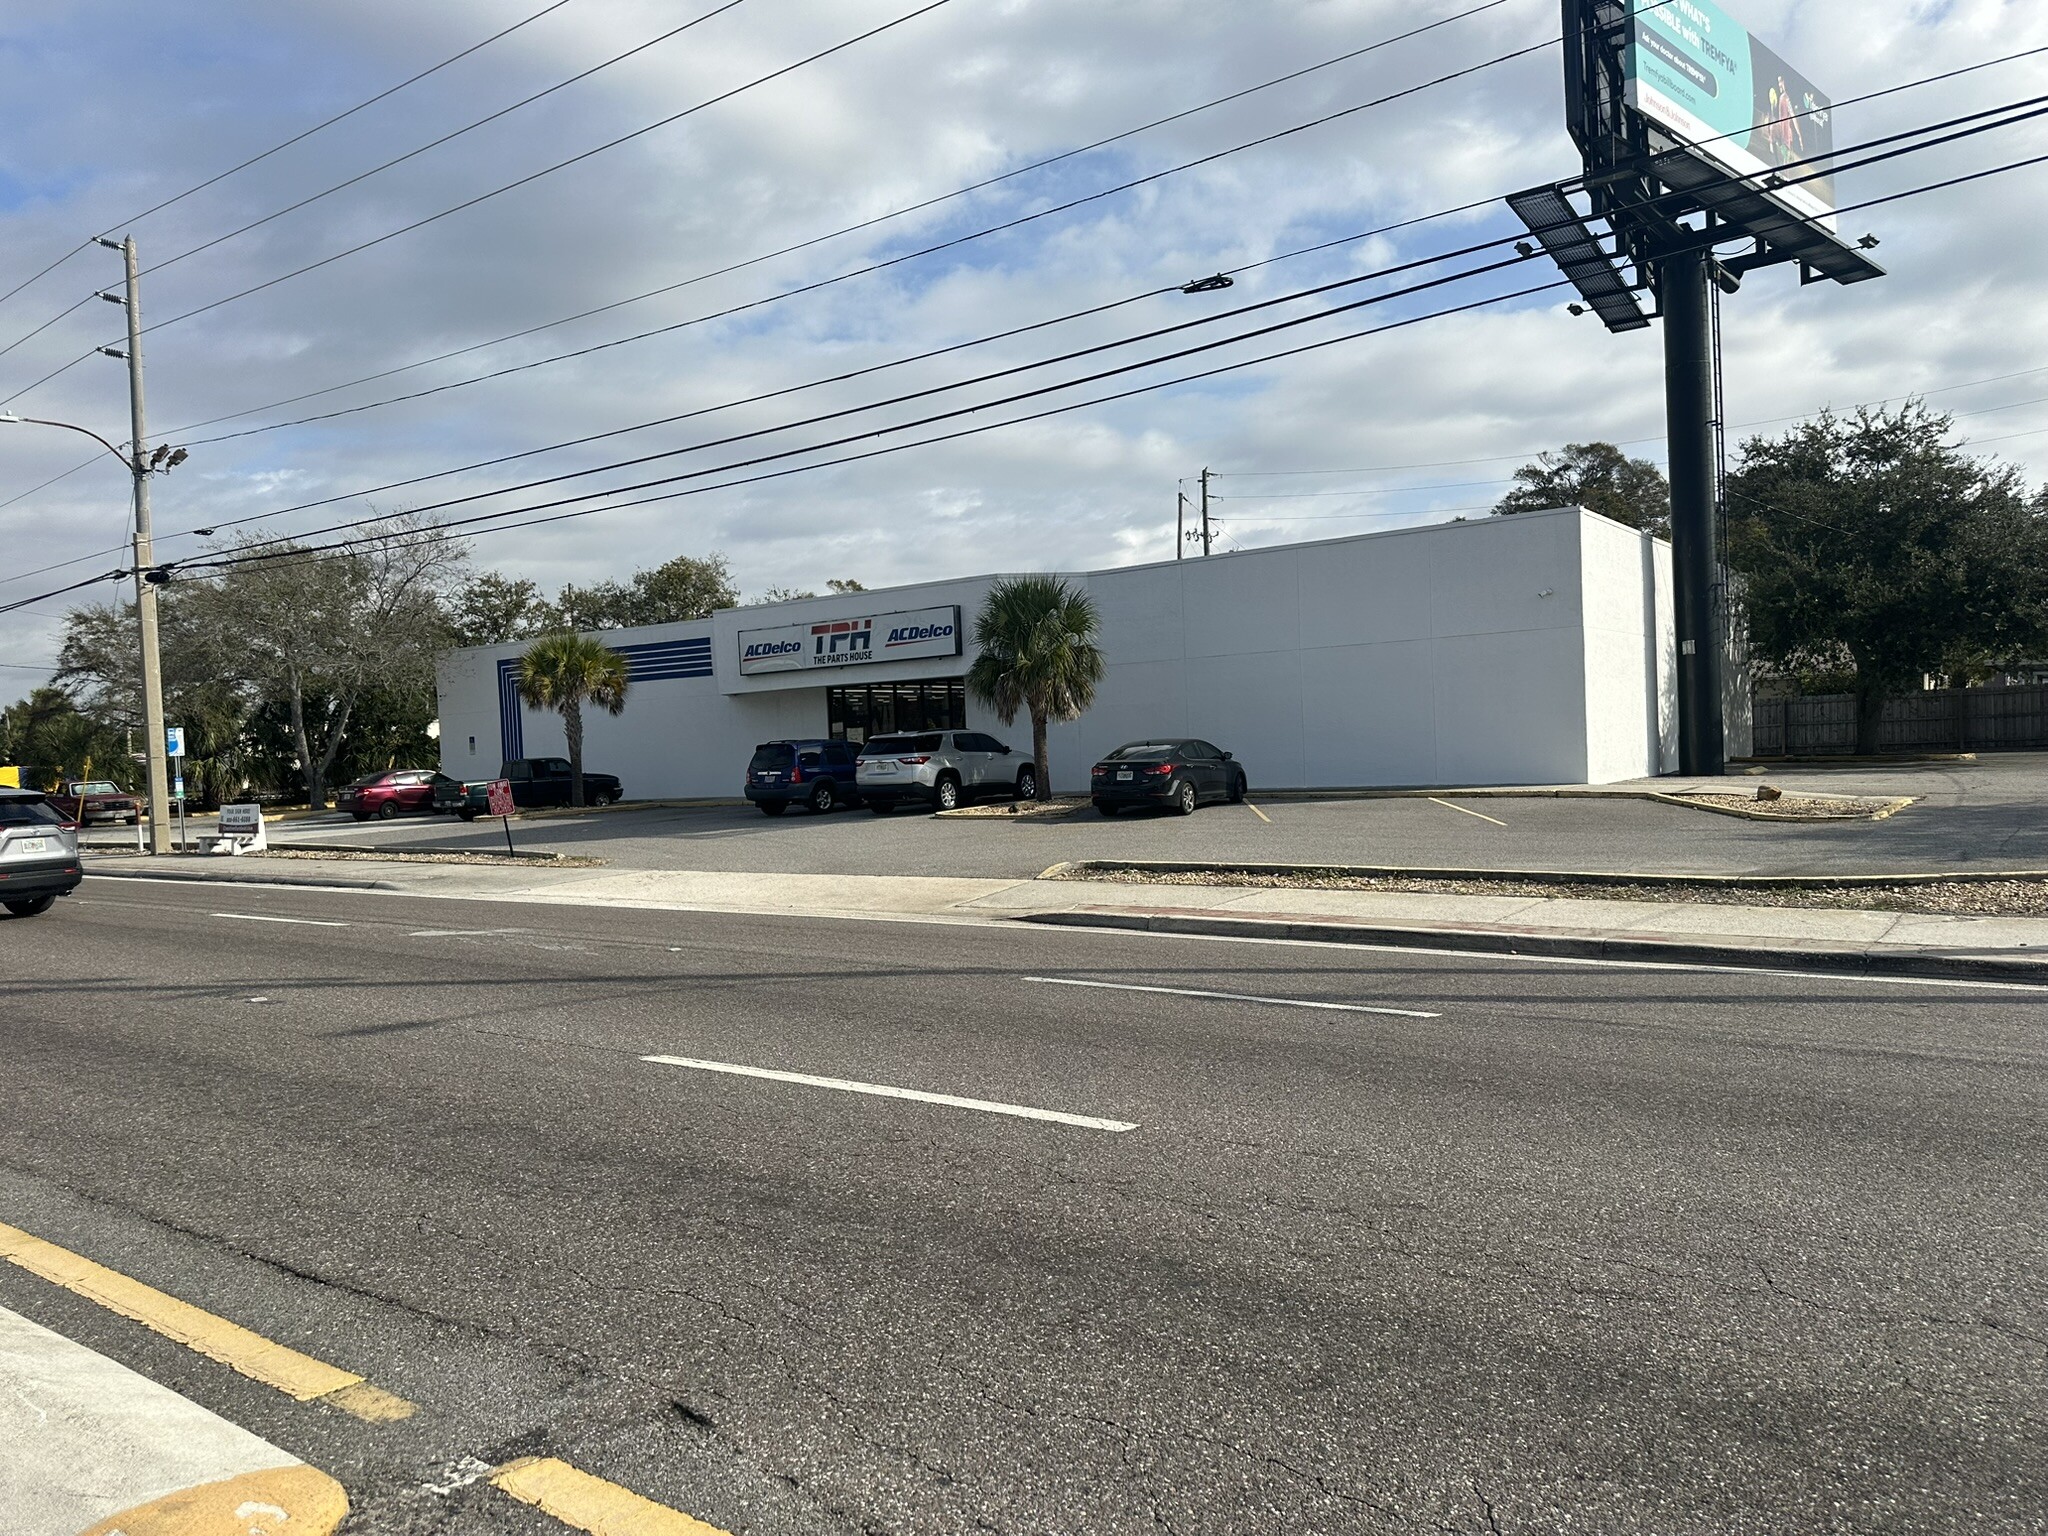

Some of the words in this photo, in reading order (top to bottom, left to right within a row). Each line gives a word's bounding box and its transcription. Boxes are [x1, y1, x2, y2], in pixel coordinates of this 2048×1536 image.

[811, 619, 872, 655] TPH
[888, 624, 954, 642] ACDelco
[745, 641, 801, 657] ACDelco
[813, 656, 826, 665] THE
[827, 653, 849, 664] PARTS
[850, 651, 873, 661] HOUSE
